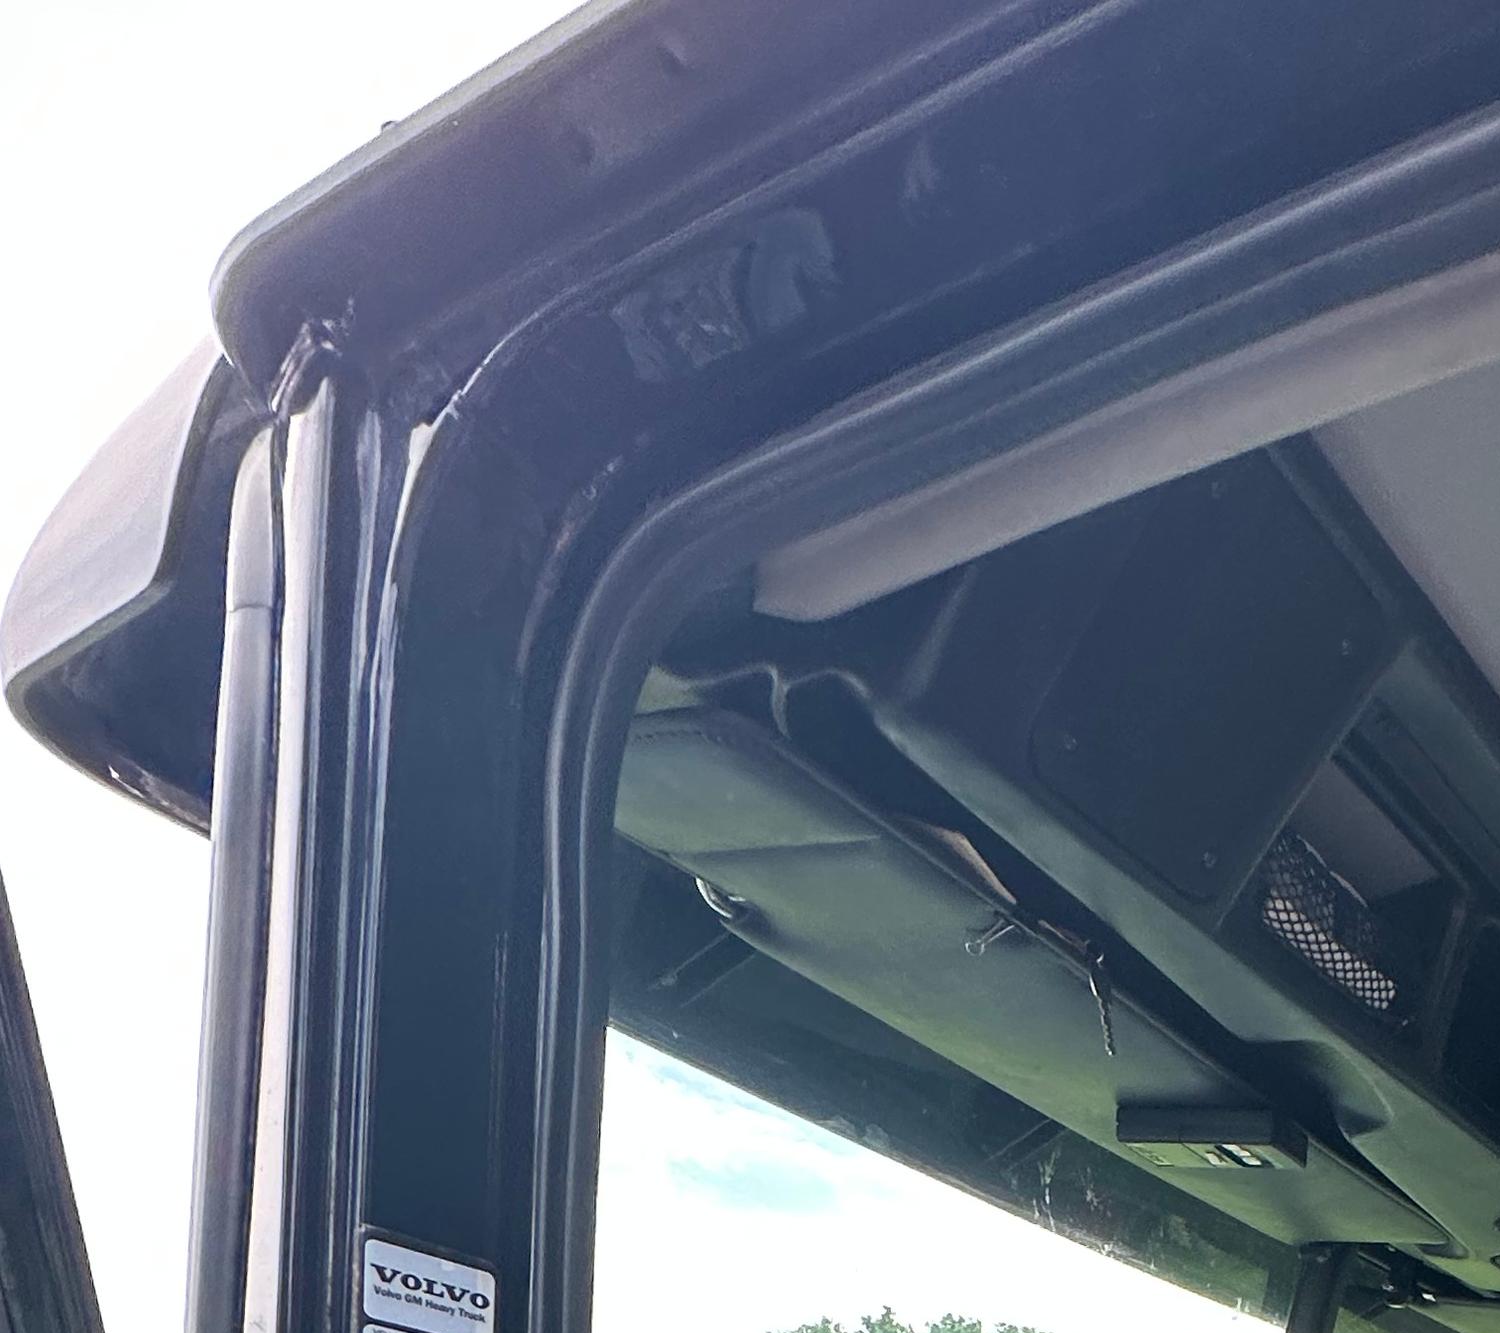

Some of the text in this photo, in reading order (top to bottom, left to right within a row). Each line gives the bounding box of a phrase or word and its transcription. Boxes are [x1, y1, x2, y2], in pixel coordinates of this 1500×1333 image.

[370, 1263, 490, 1309] VOLVO
[373, 1284, 486, 1323] Volvo GM Heavy Truck
